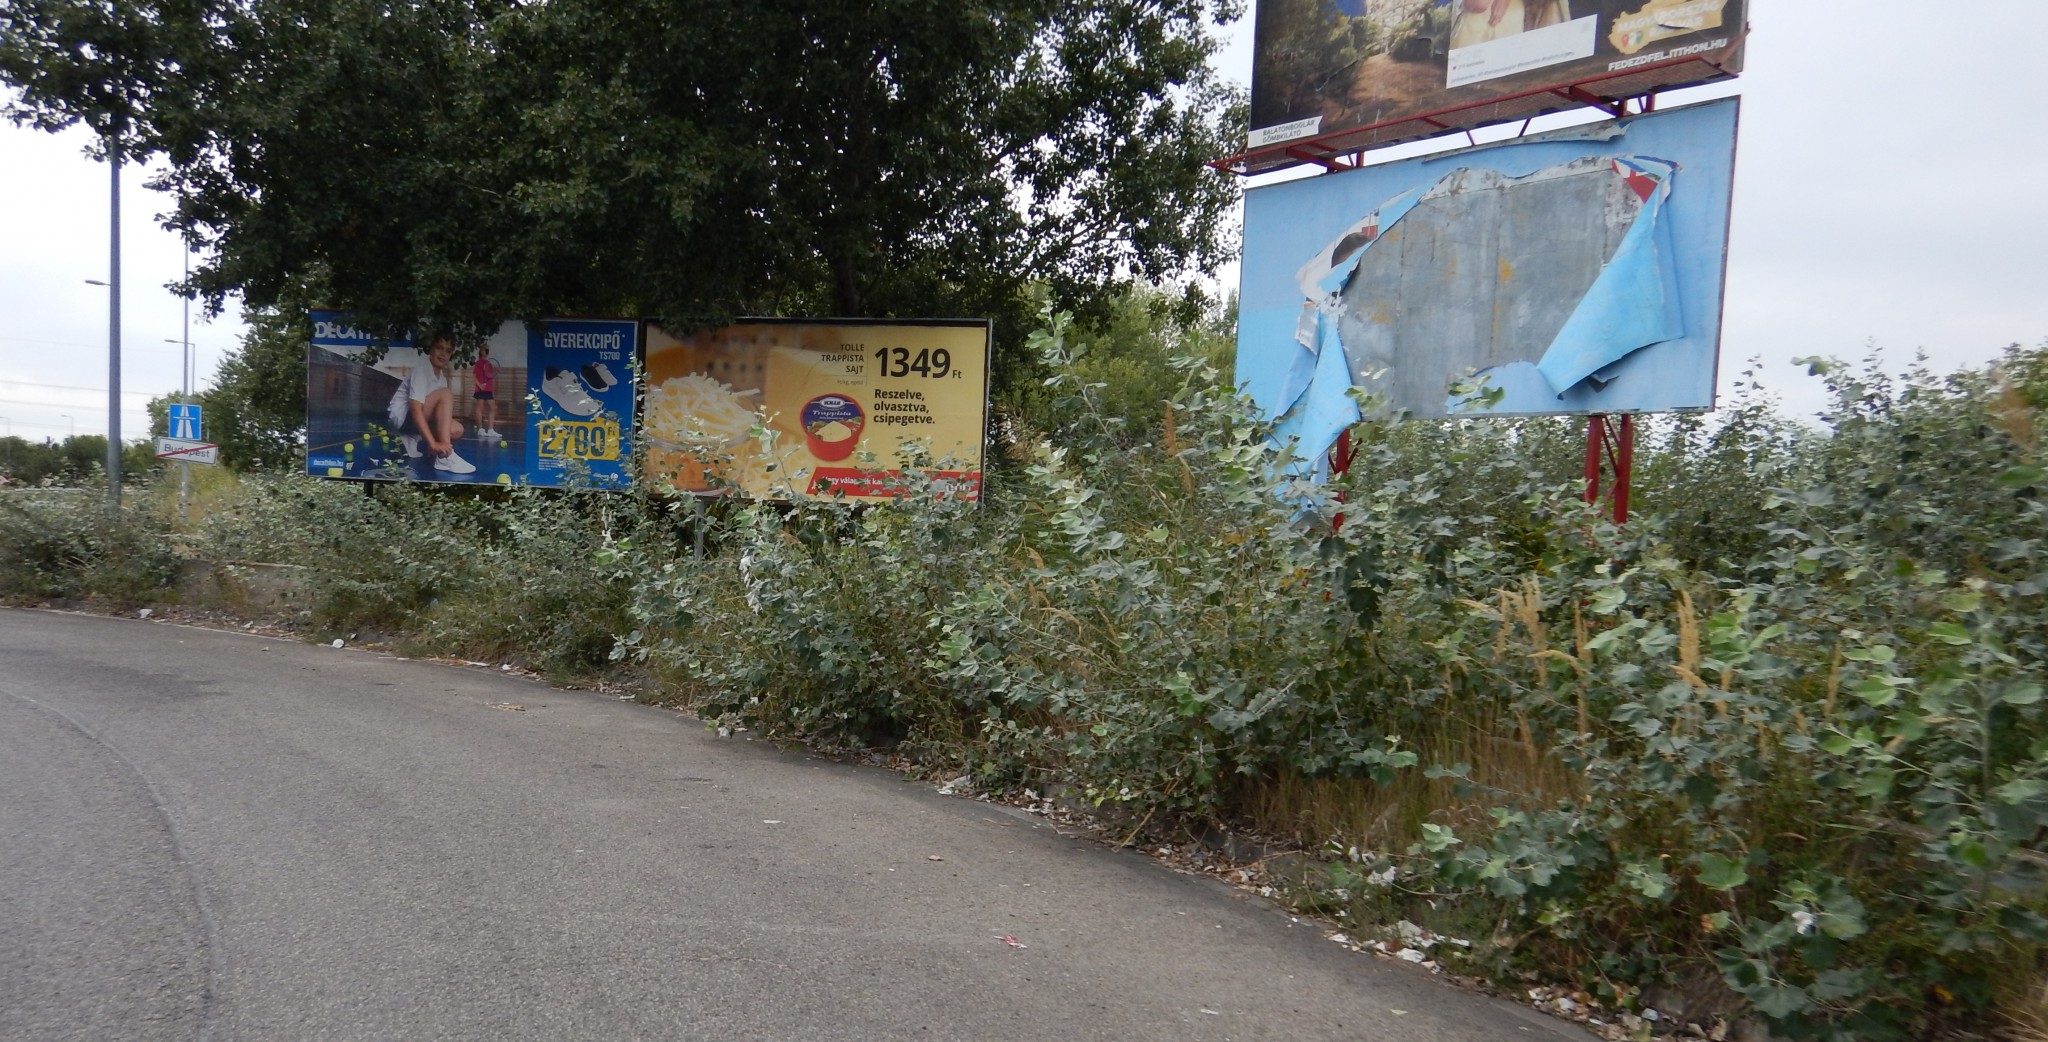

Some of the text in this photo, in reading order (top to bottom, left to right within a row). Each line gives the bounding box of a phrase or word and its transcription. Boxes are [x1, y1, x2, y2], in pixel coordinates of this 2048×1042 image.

[1608, 38, 1728, 72] FEDEZDFEL.ITTHON.HU
[1263, 119, 1315, 137] BALATONBOGLÁR
[840, 343, 865, 352] TOLLE
[599, 351, 620, 361] TS700
[821, 354, 865, 362] TRAPPISTA
[845, 365, 864, 374] SAJT
[874, 347, 962, 379] 1349 Ft
[874, 389, 925, 401] Reszelve,
[873, 401, 929, 414] olvasztva,
[873, 413, 936, 426] csipegetve.
[164, 443, 210, 459] Budapest
